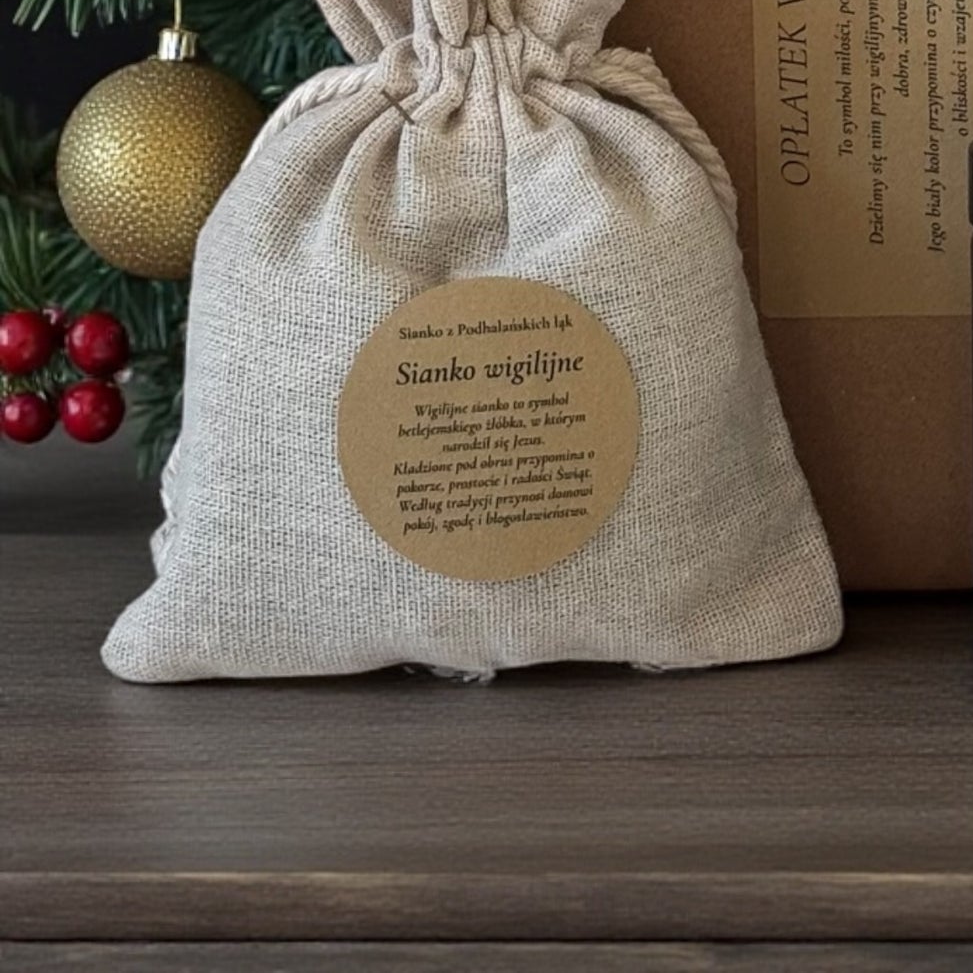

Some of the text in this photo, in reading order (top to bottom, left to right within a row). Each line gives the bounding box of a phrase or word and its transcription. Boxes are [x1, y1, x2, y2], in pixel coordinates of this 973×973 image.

[833, 20, 853, 75] miłości,
[926, 30, 937, 38] o
[893, 50, 909, 98] dobra,
[924, 43, 943, 132] przypomina
[778, 22, 810, 186] OPŁATEK
[870, 83, 886, 116] przy
[950, 61, 968, 123] bliskości
[835, 81, 858, 135] symbol
[868, 121, 882, 148] nim
[958, 128, 969, 137] o
[838, 140, 853, 156] To
[924, 136, 940, 173] kolor
[870, 156, 887, 174] się
[868, 179, 888, 245] Dzielimy
[924, 179, 946, 217] biały
[927, 223, 946, 253] Jego
[399, 324, 443, 340] Sianko
[458, 317, 550, 336] Podhalańskich
[396, 349, 584, 385] Sianko wigilijne
[415, 392, 569, 420] Wigilijne sianko to symbol
[531, 419, 541, 427] w
[544, 411, 586, 426] którym
[494, 438, 510, 451] się
[456, 456, 476, 474] pod
[480, 454, 513, 468] obrus
[516, 451, 584, 469] przypomina
[588, 450, 595, 460] o
[504, 475, 508, 487] i
[446, 494, 492, 511] tradycji
[496, 490, 545, 509] przynosi
[548, 484, 593, 499] domowi
[478, 513, 482, 525] i
